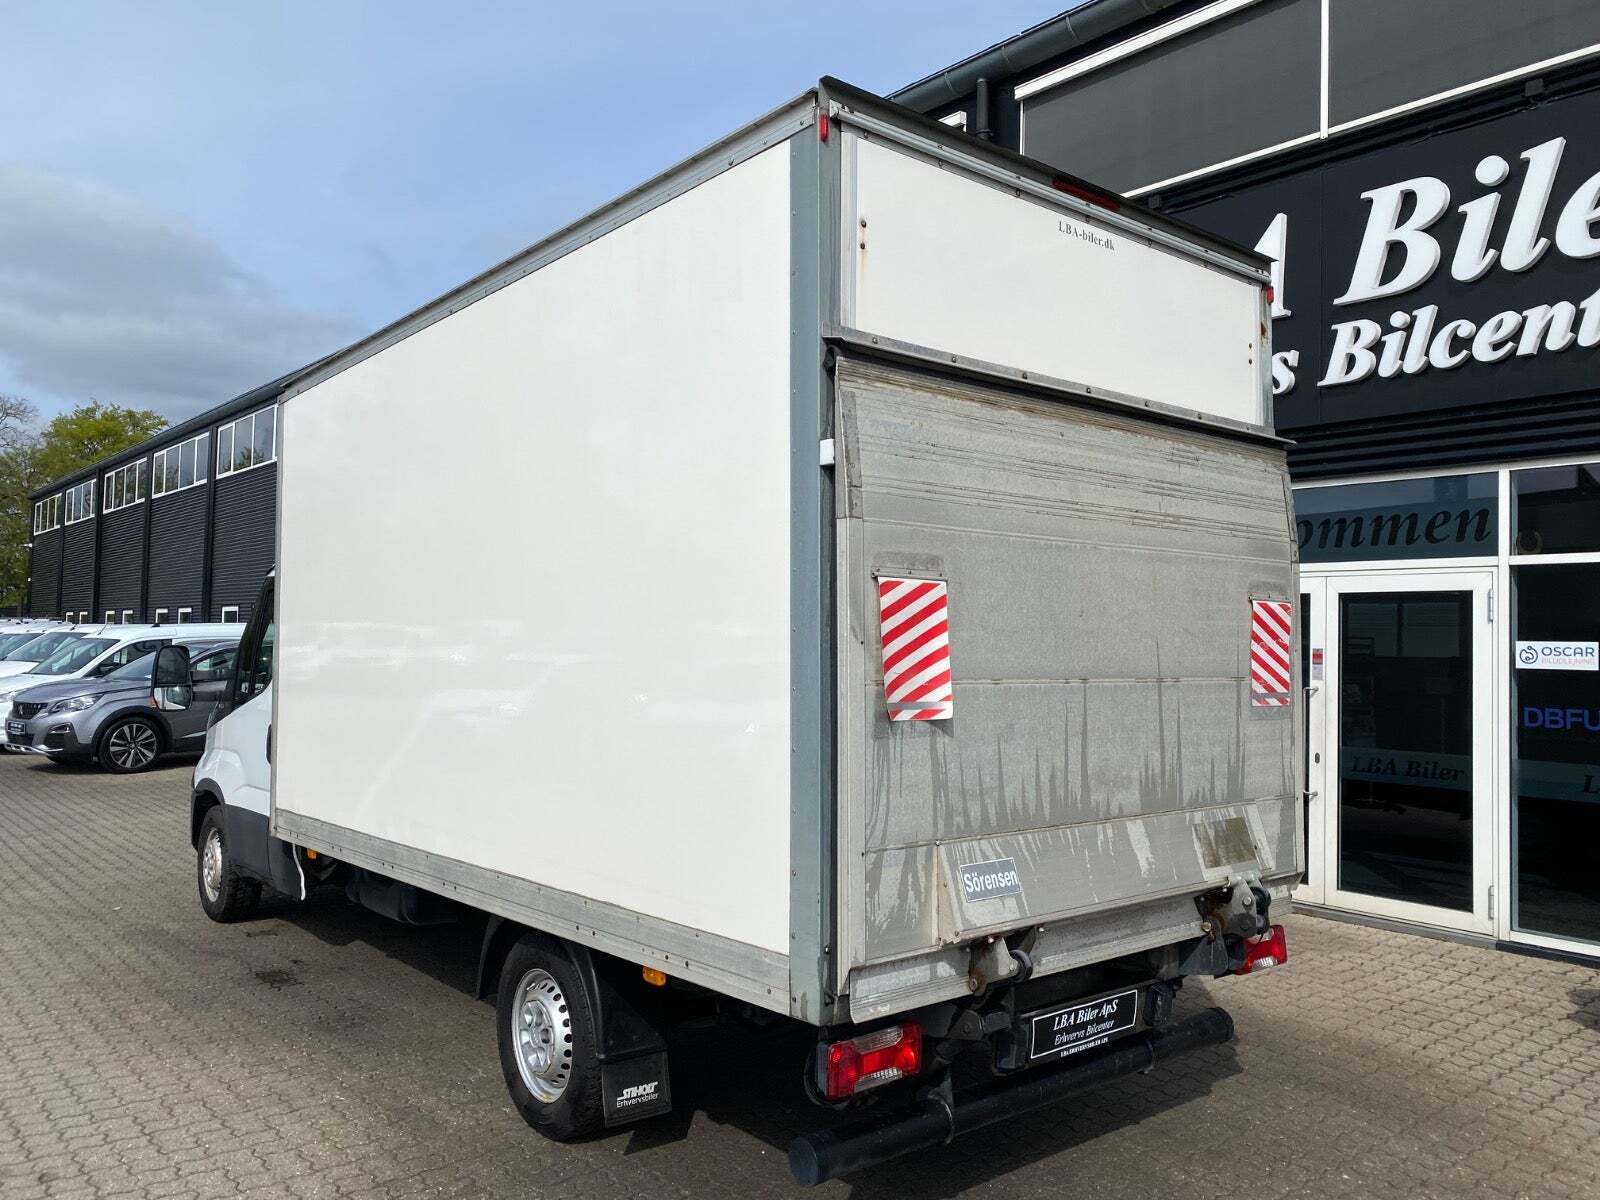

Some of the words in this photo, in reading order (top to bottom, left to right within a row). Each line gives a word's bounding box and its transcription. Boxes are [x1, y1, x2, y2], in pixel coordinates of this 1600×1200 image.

[1058, 220, 1115, 251] LBA-biler.dk
[1541, 646, 1595, 657] OSCAR
[1351, 757, 1397, 776] LBA
[1405, 760, 1465, 781] Biler
[963, 870, 1018, 893] Sörensen
[1053, 1012, 1075, 1031] LBA
[1076, 1007, 1099, 1024] Biler
[1099, 999, 1119, 1018] ApS
[1054, 1029, 1086, 1046] Erhvervs
[1086, 1020, 1115, 1036] Bilcenter
[616, 1093, 660, 1108] Erhvervsbiler
